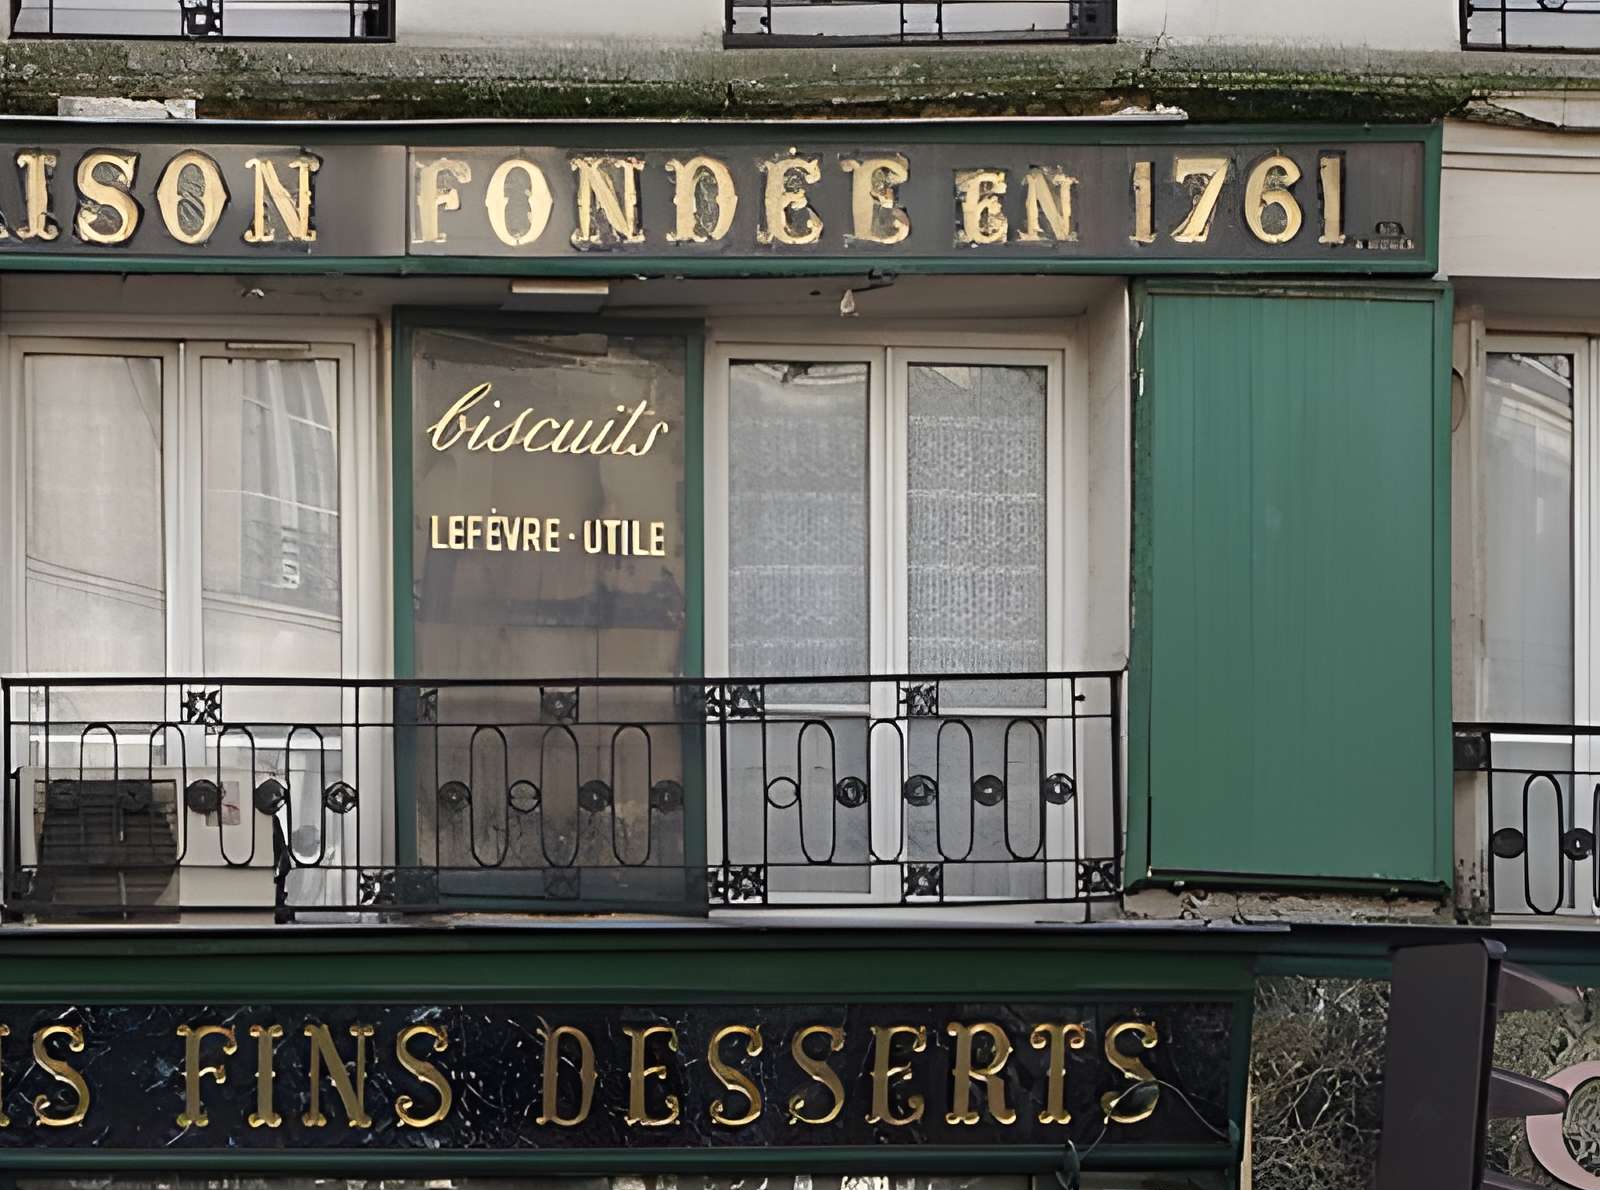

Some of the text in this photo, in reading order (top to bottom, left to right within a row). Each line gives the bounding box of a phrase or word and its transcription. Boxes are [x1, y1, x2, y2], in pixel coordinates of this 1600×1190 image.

[1129, 149, 1347, 245] 1761
[426, 382, 669, 457] biscuits
[583, 518, 666, 556] UTILE
[176, 1023, 453, 1128] FINS
[534, 1021, 1159, 1127] DESSERTS
